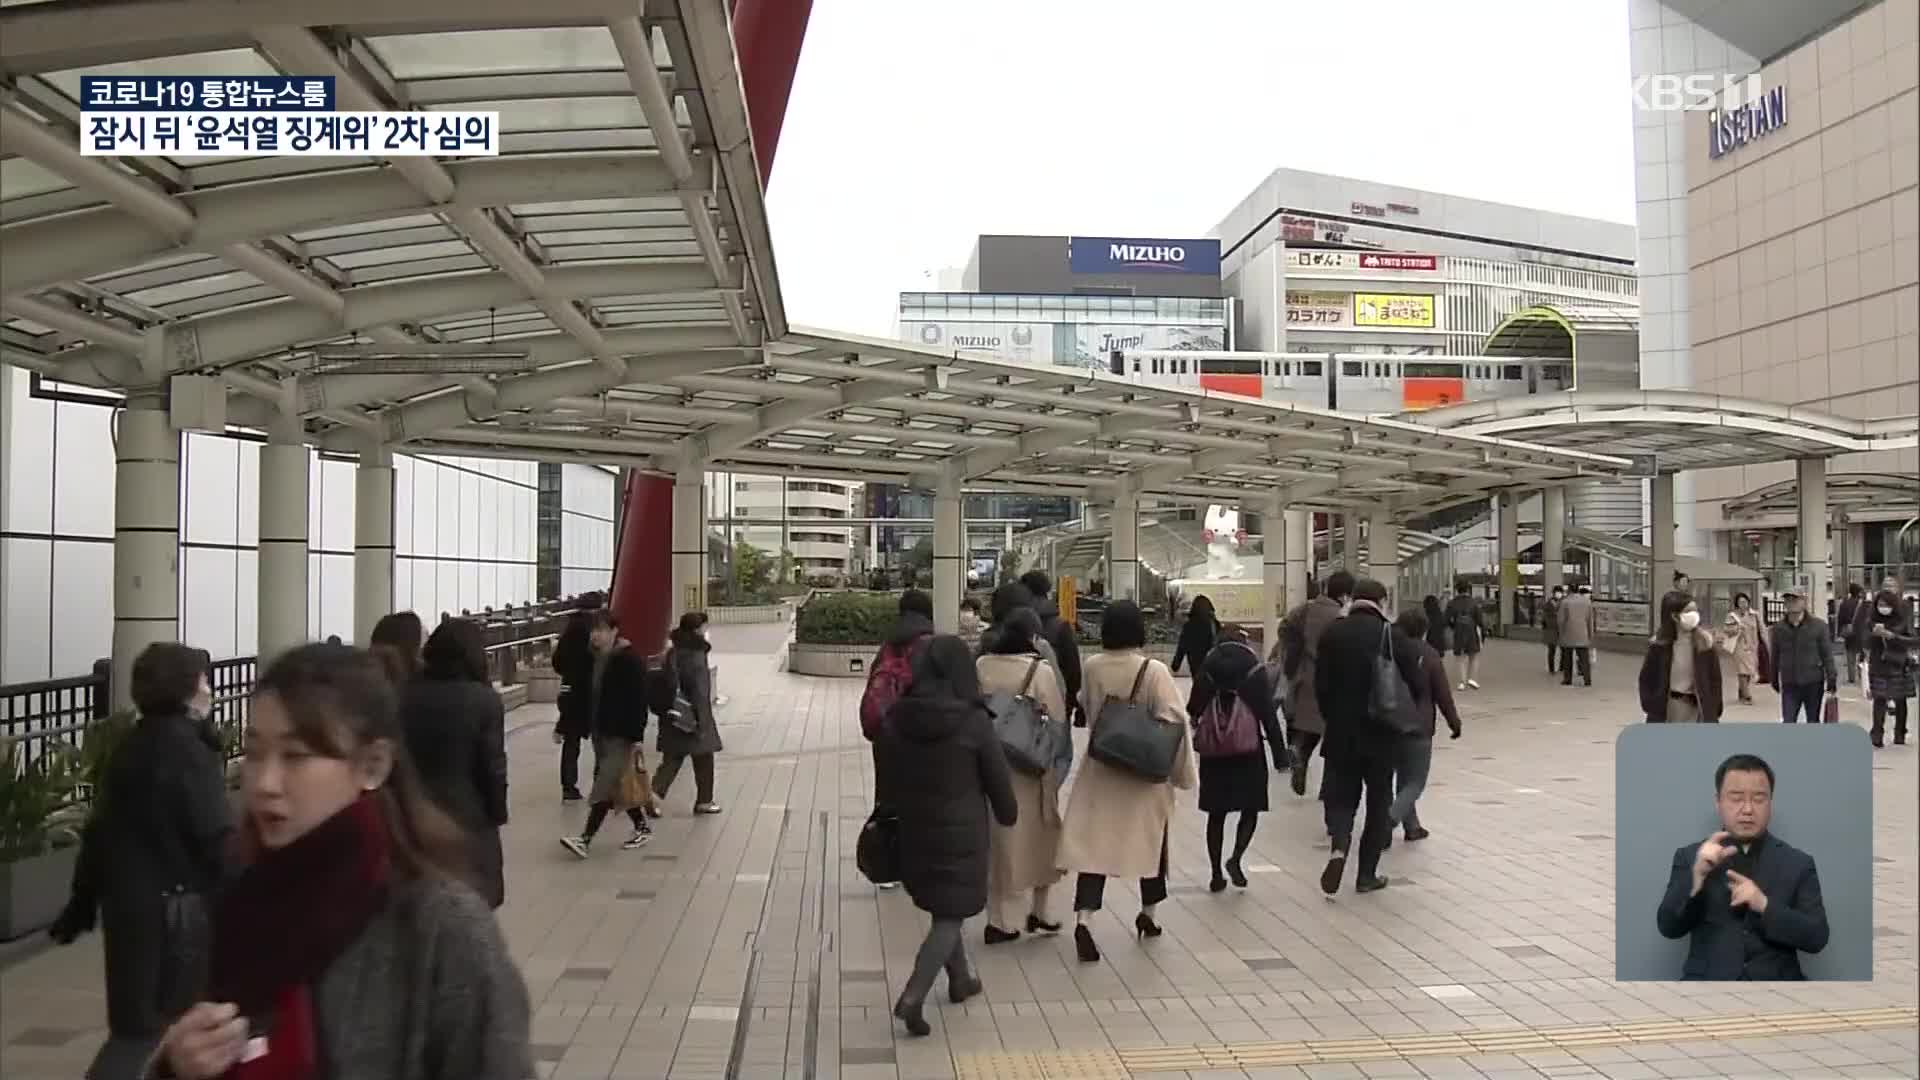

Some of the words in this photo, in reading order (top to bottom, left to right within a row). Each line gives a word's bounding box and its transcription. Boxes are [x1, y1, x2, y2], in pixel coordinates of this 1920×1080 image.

[1110, 244, 1185, 261] MIZUHO
[1287, 309, 1341, 322] カラオケ
[953, 335, 1001, 346] MIZUHO
